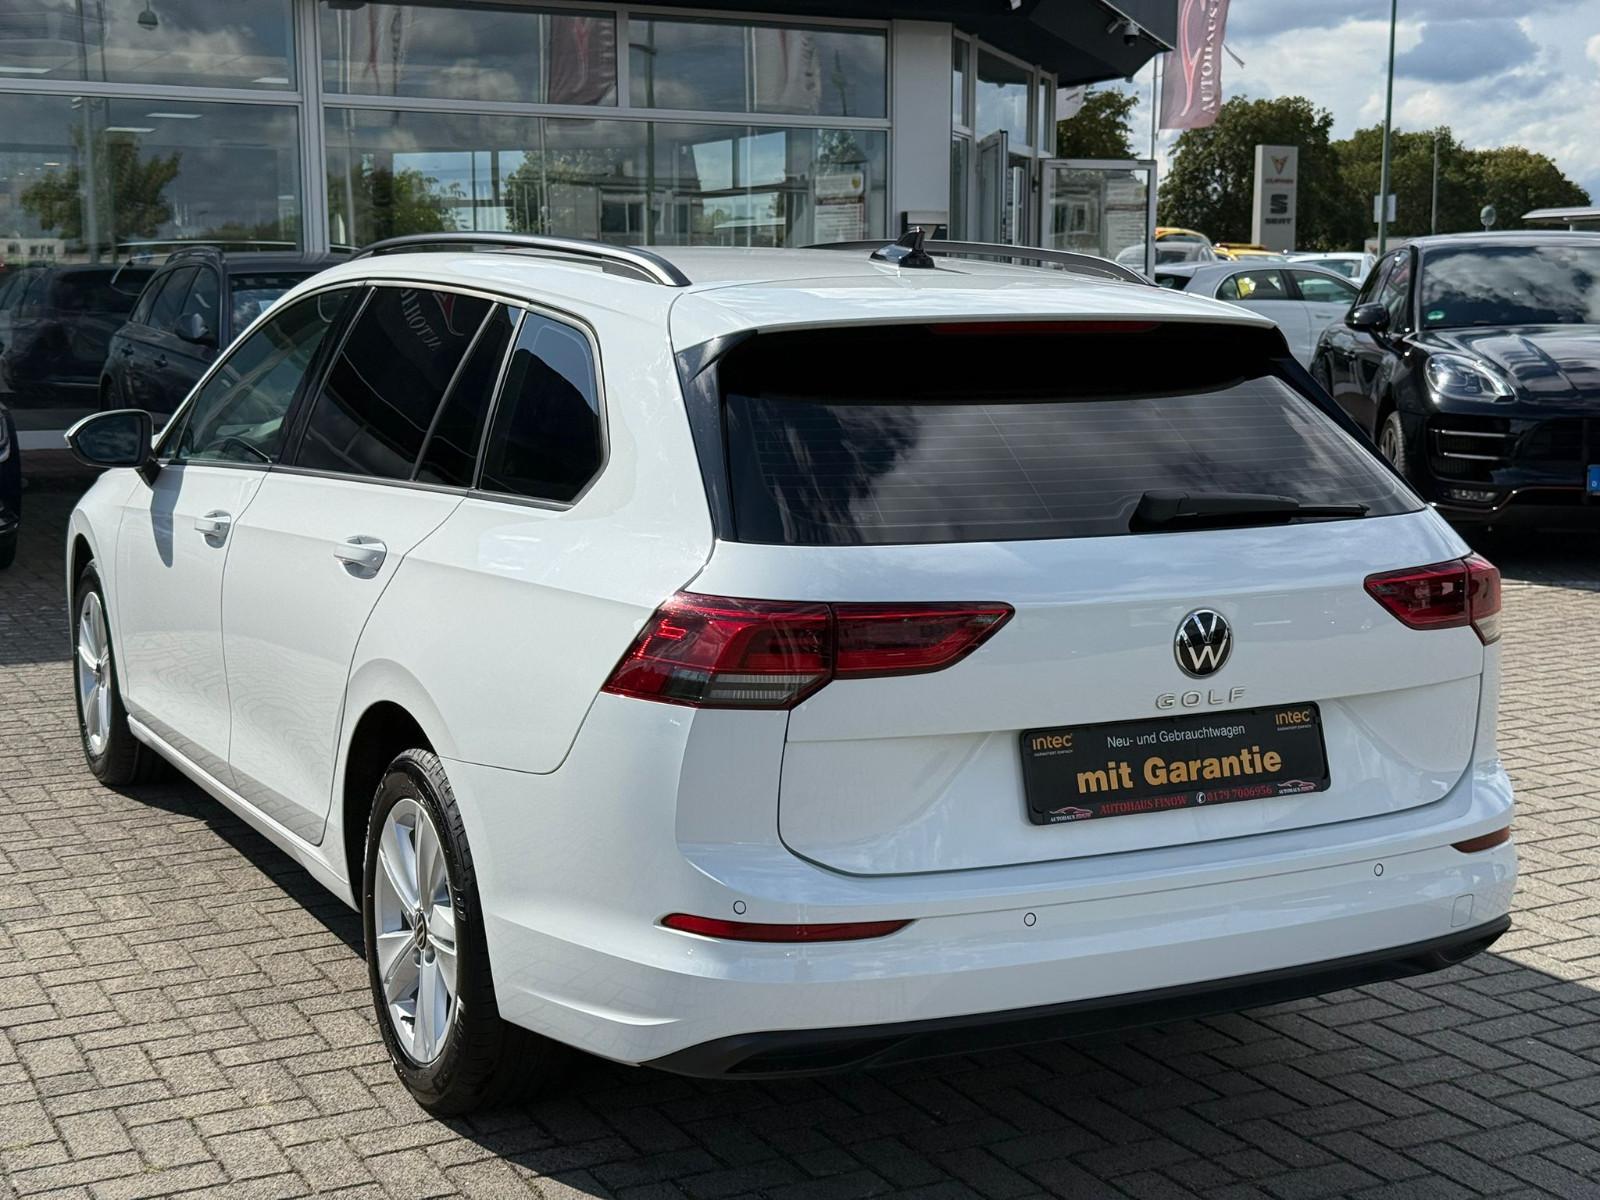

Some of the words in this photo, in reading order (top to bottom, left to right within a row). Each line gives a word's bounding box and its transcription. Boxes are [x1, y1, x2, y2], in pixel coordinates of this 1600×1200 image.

[1200, 7, 1217, 114] AUTOHAUS
[1156, 686, 1246, 710] GOLF
[1275, 709, 1311, 725] intec
[1032, 733, 1073, 750] intec
[1107, 736, 1134, 749] Neu-
[1137, 731, 1157, 745] und
[1159, 725, 1246, 743] Gebrauchtwagen
[1077, 761, 1134, 794] mit
[1144, 746, 1282, 786] Garantie
[1100, 799, 1151, 815] AUTOHAUS
[1152, 795, 1187, 809] FINOW
